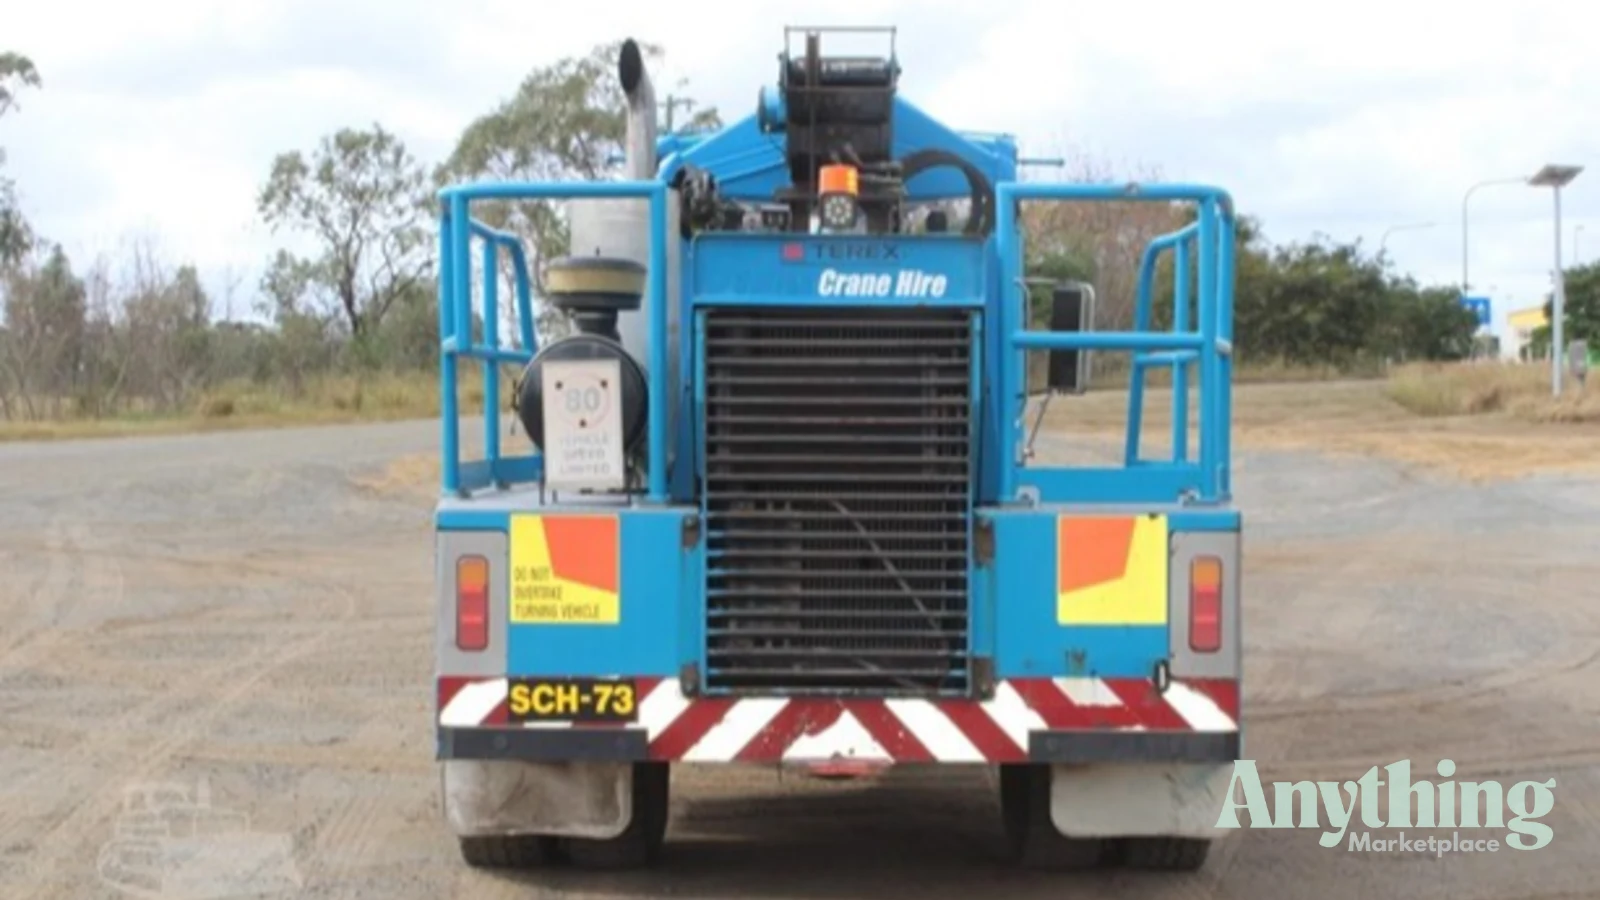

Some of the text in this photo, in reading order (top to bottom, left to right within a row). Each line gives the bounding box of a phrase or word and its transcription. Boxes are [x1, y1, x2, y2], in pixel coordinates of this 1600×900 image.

[817, 267, 892, 297] Crane
[894, 268, 948, 298] Hire
[564, 387, 601, 413] 80
[514, 566, 550, 582] DO NOT
[514, 603, 600, 620] TURNING VEHICLE
[509, 683, 635, 715] SCH-73
